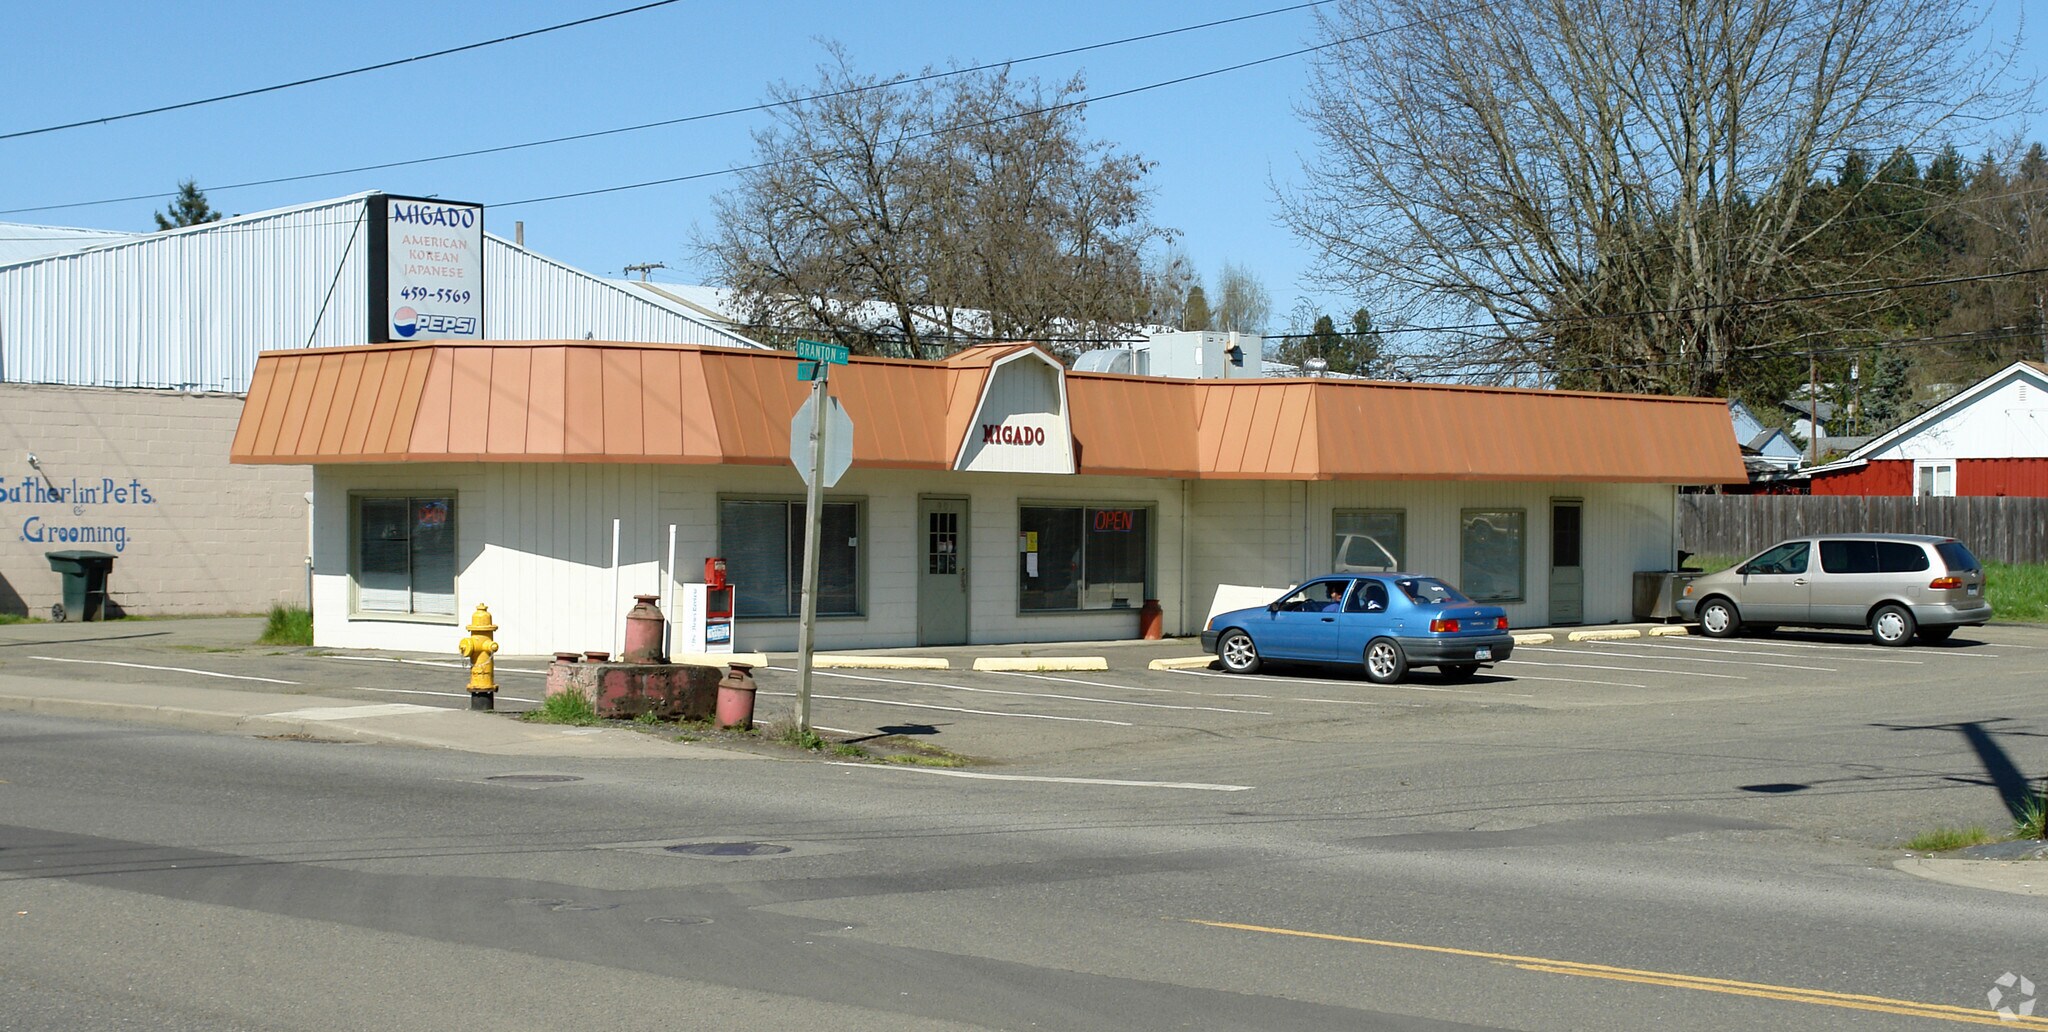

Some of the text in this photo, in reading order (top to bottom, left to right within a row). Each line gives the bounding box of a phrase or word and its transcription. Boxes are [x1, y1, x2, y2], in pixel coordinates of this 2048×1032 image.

[394, 203, 475, 228] MIGADO
[402, 234, 467, 249] AMERICAN
[409, 249, 459, 263] KOREAN
[404, 264, 464, 278] JAPANESE
[401, 286, 471, 304] 459-5569
[415, 314, 476, 334] PEPSI
[799, 342, 846, 361] BRANTON ST
[982, 424, 1045, 446] MIGADO
[1095, 511, 1132, 531] OPEN
